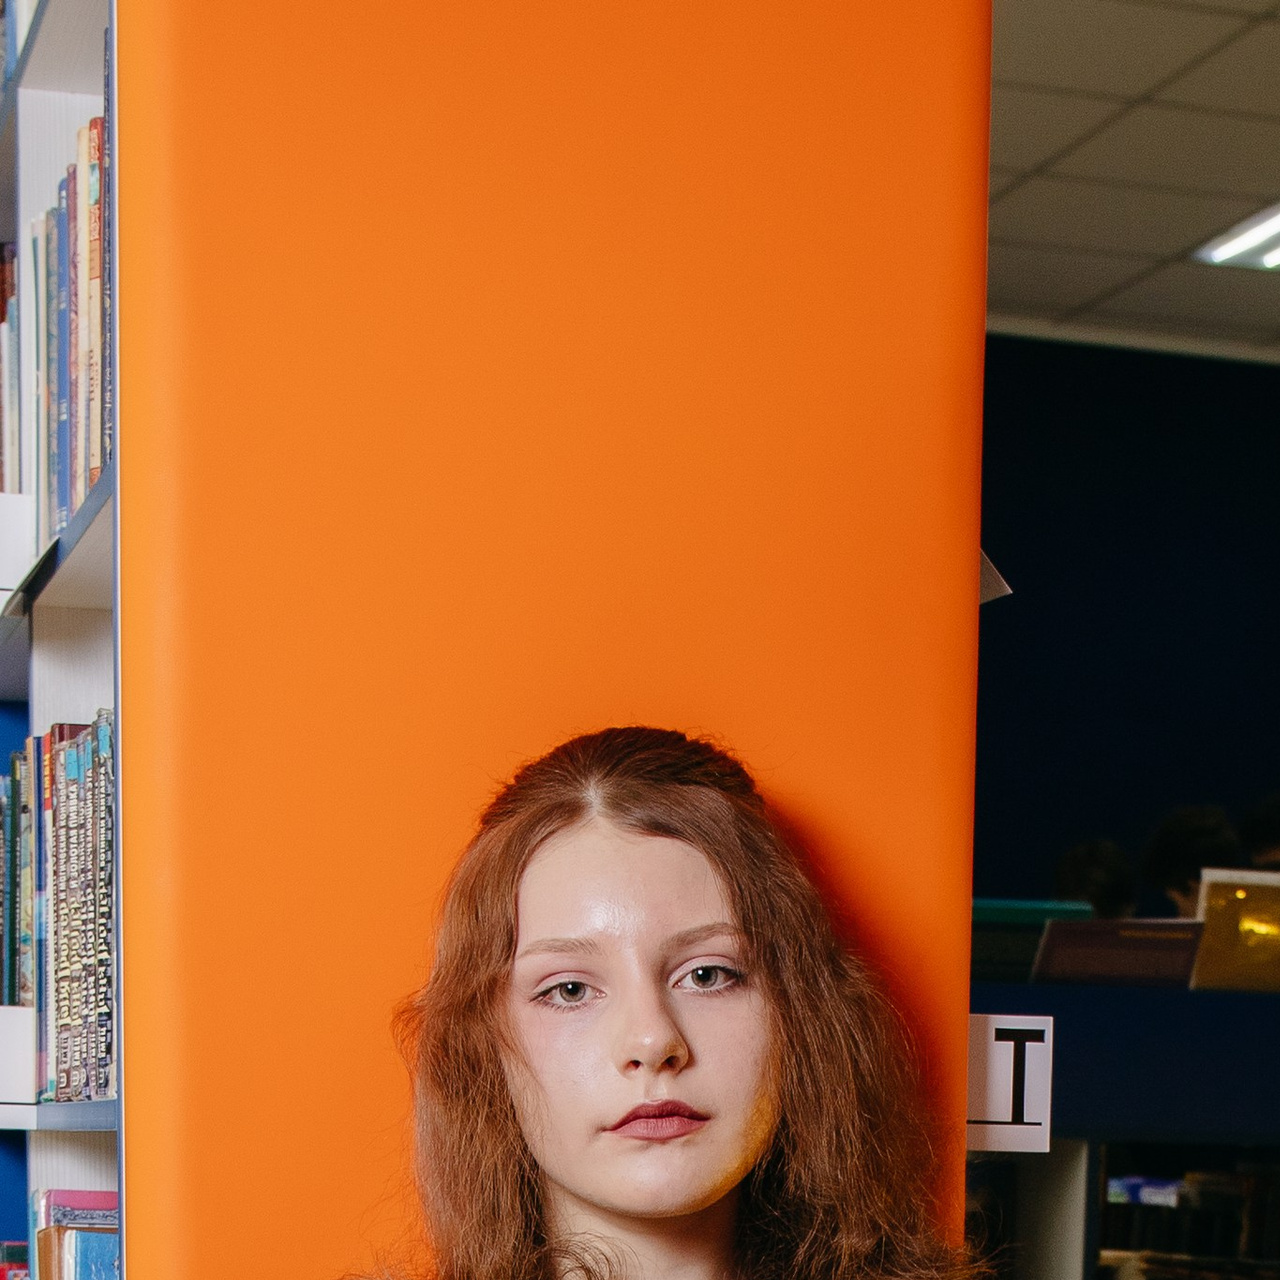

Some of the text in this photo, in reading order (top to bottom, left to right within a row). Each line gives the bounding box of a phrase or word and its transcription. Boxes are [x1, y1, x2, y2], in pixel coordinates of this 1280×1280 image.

[70, 784, 78, 828] ПИЯВКА
[70, 829, 78, 877] ЗОЛОТАЯ
[994, 1027, 1046, 1124] Т
